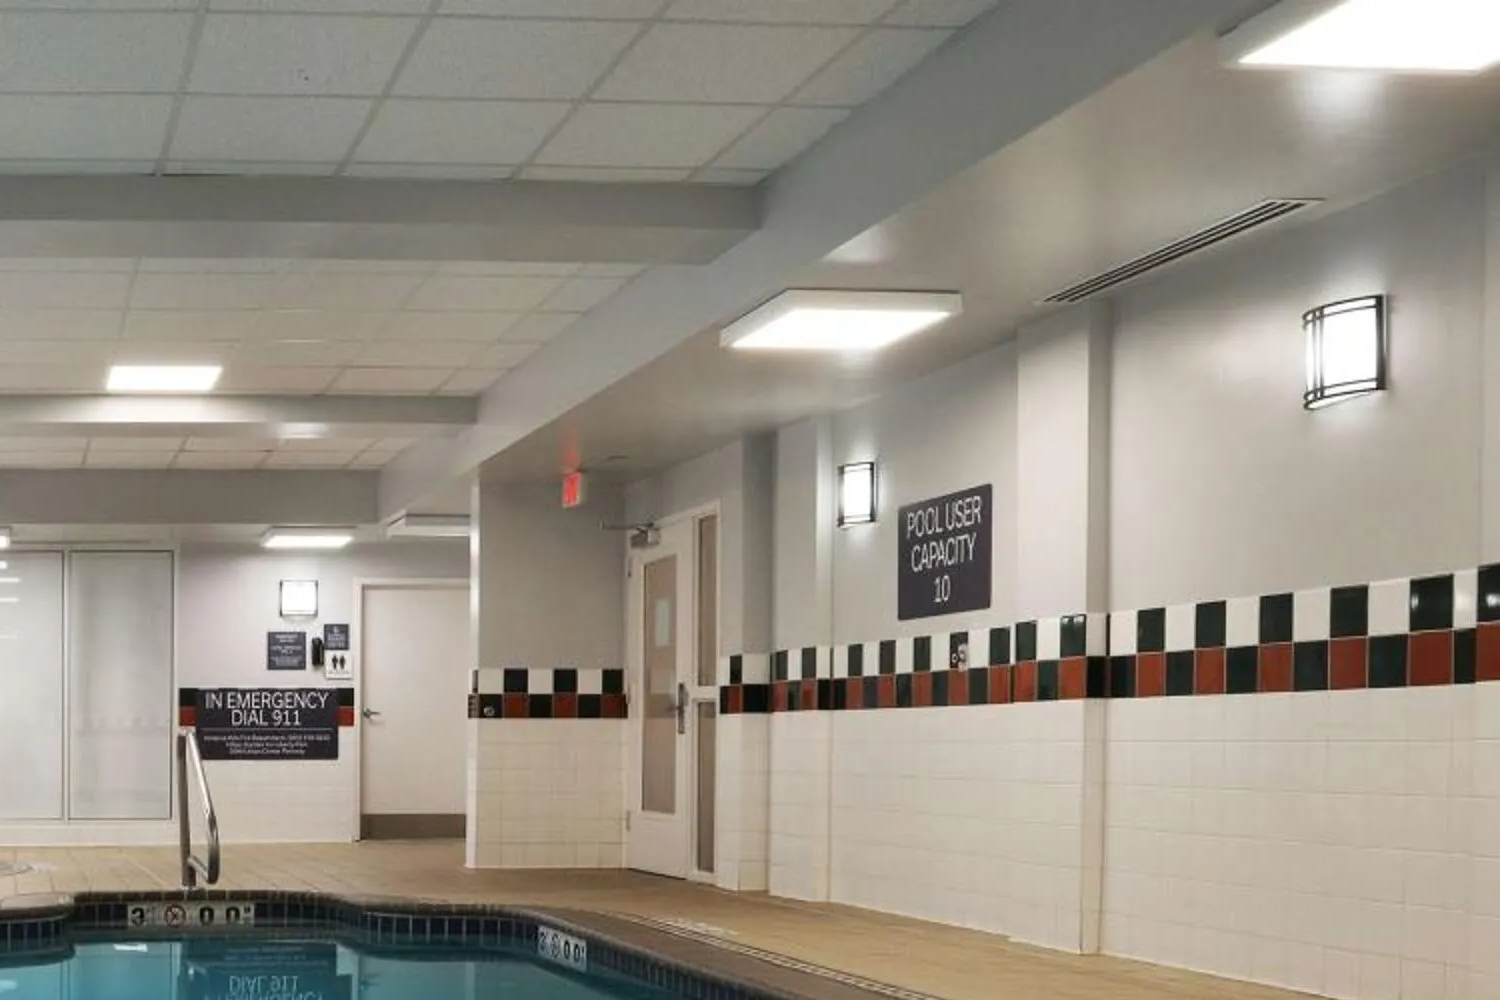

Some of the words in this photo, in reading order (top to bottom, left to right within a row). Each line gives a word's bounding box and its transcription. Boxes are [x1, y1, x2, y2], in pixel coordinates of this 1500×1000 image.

[906, 506, 943, 539] POOL
[945, 496, 982, 531] USER
[911, 532, 977, 573] CAPACITY
[934, 575, 951, 603] 10
[205, 692, 223, 709] IN
[227, 692, 328, 709] EMERGENCY
[231, 710, 269, 726] DIAL
[273, 710, 301, 726] 911
